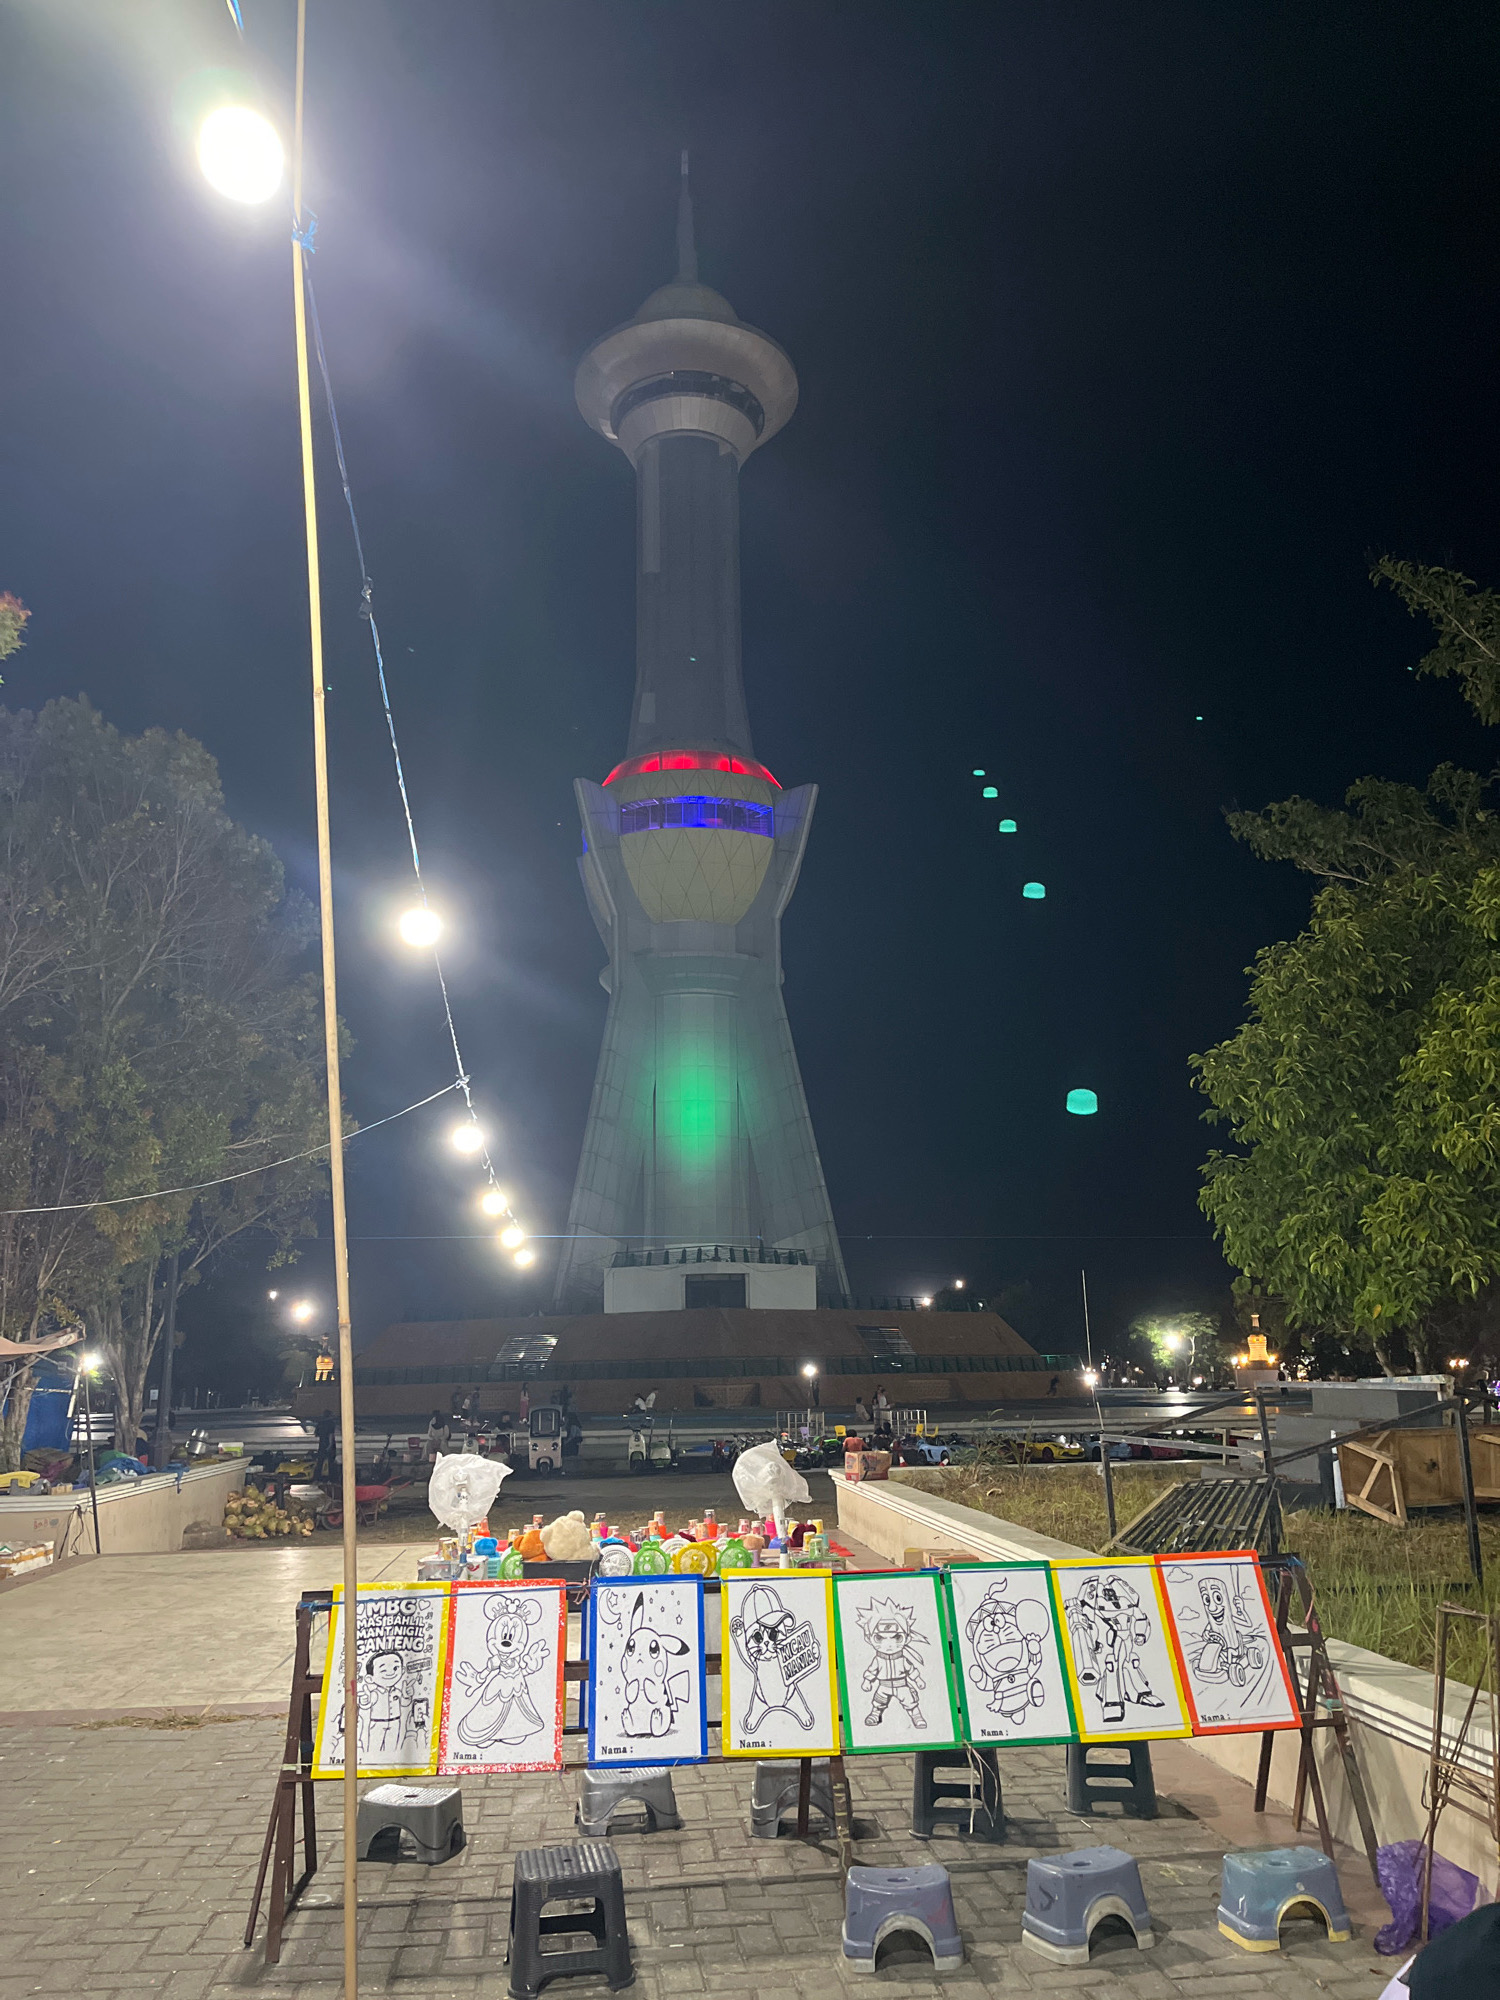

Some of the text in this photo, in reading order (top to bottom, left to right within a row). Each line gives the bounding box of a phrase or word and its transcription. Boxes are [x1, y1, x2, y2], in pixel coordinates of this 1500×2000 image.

[366, 1598, 417, 1617] MBG
[357, 1615, 426, 1629] MAS BAHLIL
[357, 1636, 425, 1655] GANTENG
[780, 1630, 811, 1663] KICAU
[783, 1649, 815, 1681] MANIA
